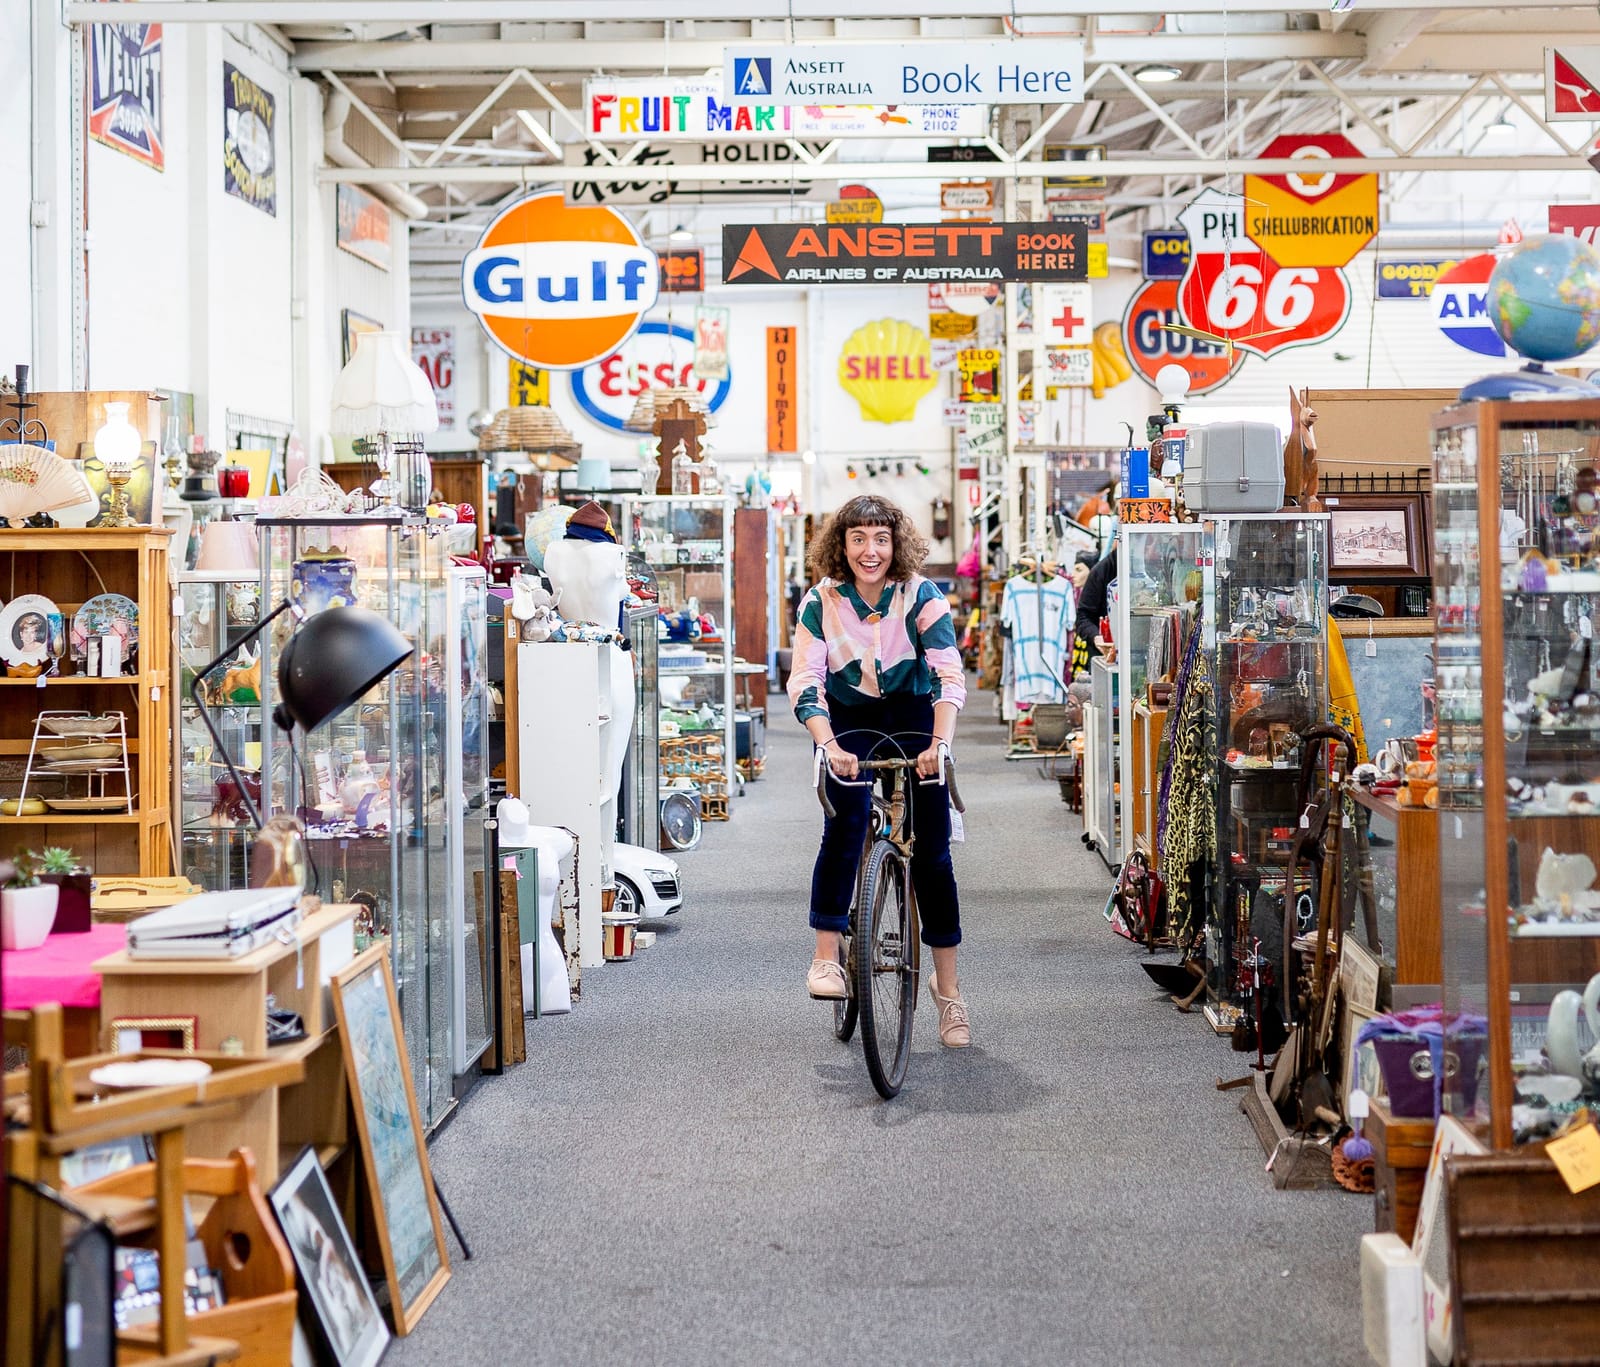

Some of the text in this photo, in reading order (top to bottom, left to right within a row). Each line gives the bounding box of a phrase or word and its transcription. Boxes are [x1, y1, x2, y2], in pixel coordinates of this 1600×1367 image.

[785, 58, 845, 74] ANSETT
[95, 23, 160, 132] VELVET
[785, 80, 873, 95] AUSTRALIA
[903, 63, 1072, 94] Book Here
[118, 105, 143, 138] SOAP
[592, 95, 691, 133] FRUIT
[922, 108, 960, 119] PHONE
[923, 120, 958, 131] 21102
[829, 201, 878, 216] DUNLOP
[1253, 215, 1375, 237] SHELLUBRICATION
[786, 227, 1004, 257] ANSETT
[1016, 233, 1076, 251] BOOK
[1016, 253, 1076, 270] HERE!
[473, 256, 647, 303] Gulf
[785, 267, 1004, 280] AIRLINES OF AUSTRALIA
[1207, 263, 1320, 330] 66
[1438, 293, 1489, 318] AM
[961, 350, 995, 361] SELO
[846, 355, 931, 380] SHELL
[970, 414, 1003, 425] TO LET
